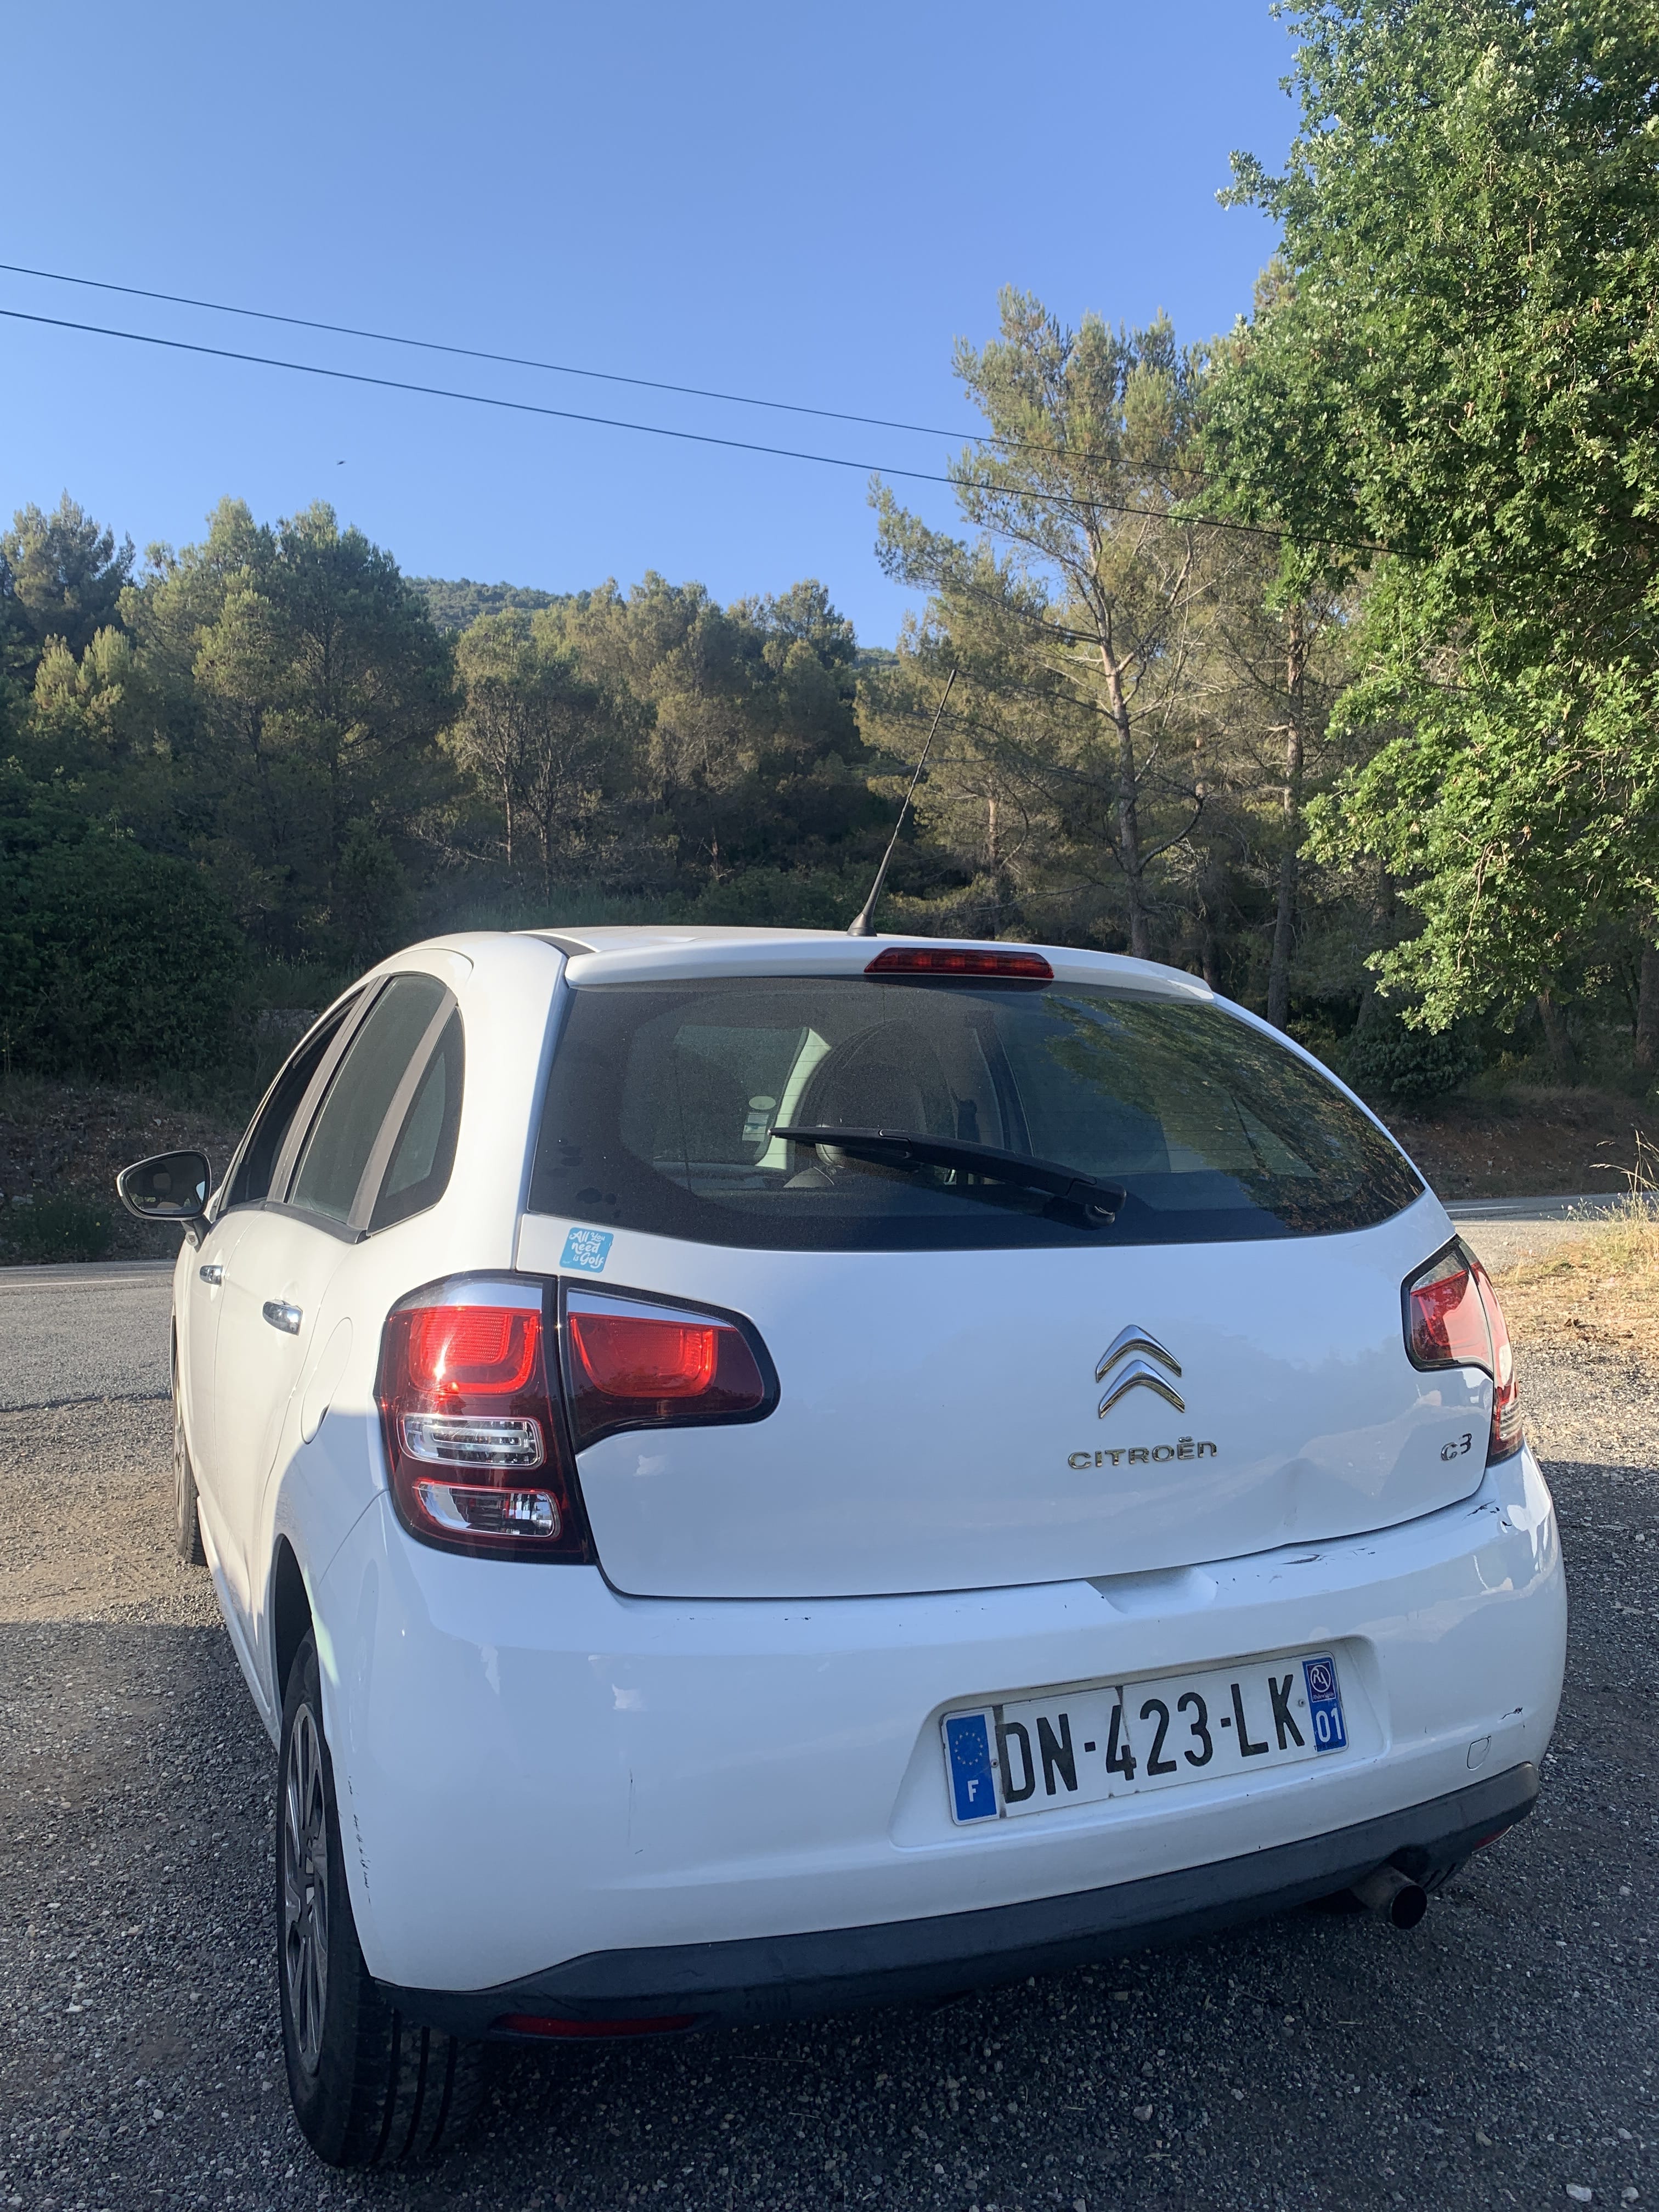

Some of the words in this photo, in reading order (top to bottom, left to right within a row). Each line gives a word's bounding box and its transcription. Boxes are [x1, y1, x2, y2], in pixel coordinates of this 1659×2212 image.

[569, 1231, 590, 1243] All
[591, 1233, 605, 1242] You
[572, 1241, 601, 1254] need
[580, 1252, 604, 1268] Golf
[1441, 1433, 1472, 1460] C3
[1316, 1707, 1342, 1742] 01
[994, 1674, 1305, 1803] DN-423-LK
[968, 1779, 980, 1803] F
